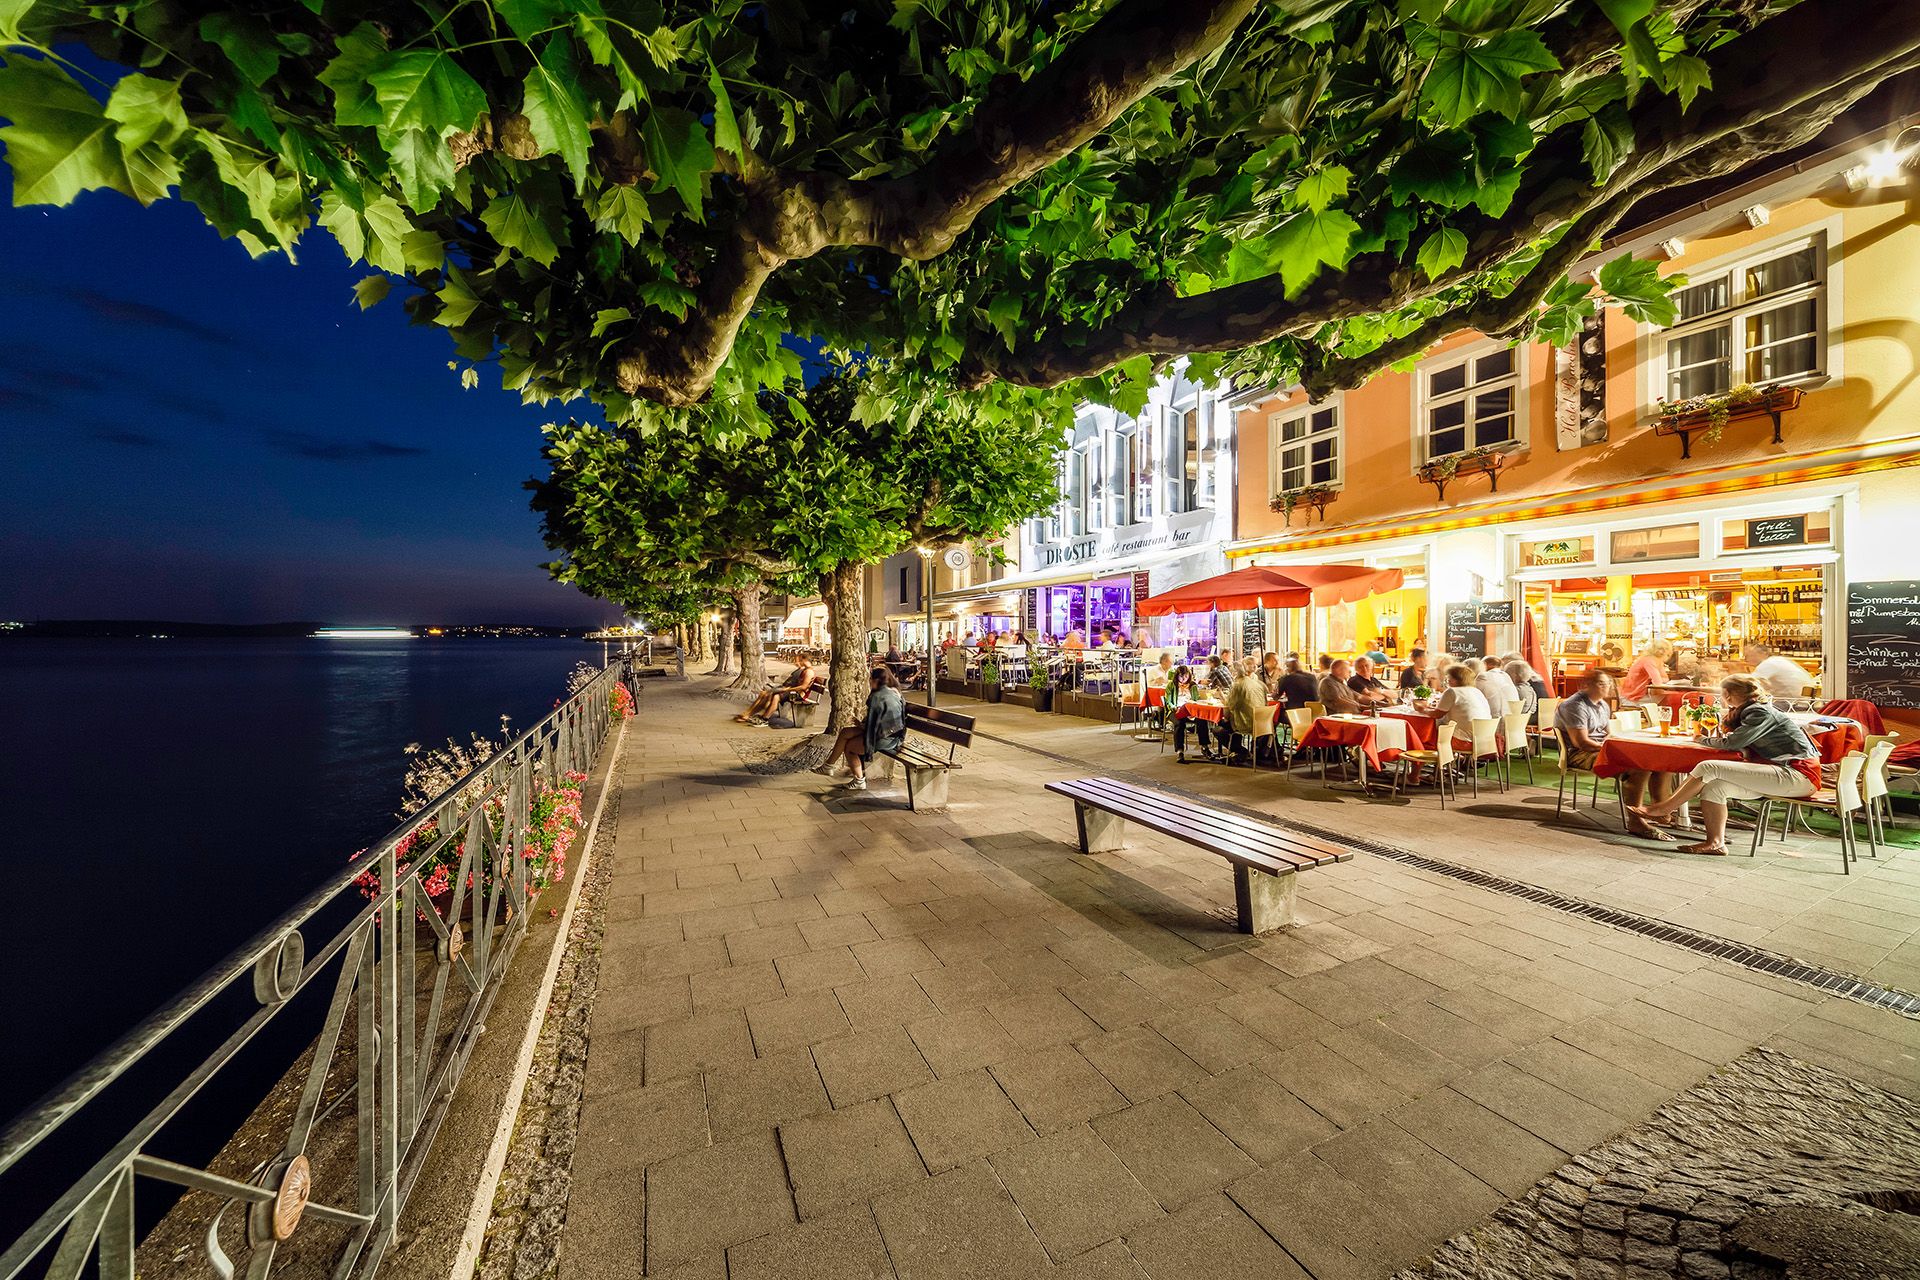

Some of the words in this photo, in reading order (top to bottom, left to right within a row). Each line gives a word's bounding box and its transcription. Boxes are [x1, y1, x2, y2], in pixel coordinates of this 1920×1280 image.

[1561, 338, 1577, 397] Bacchu
[1560, 397, 1576, 438] Hotel
[1121, 535, 1168, 552] restaurant
[1172, 529, 1191, 542] bar
[1758, 532, 1797, 543] teller
[1848, 592, 1920, 605] Sommersal
[1849, 606, 1866, 618] mit
[1849, 644, 1908, 657] Schinken
[1848, 657, 1888, 669] Spinat
